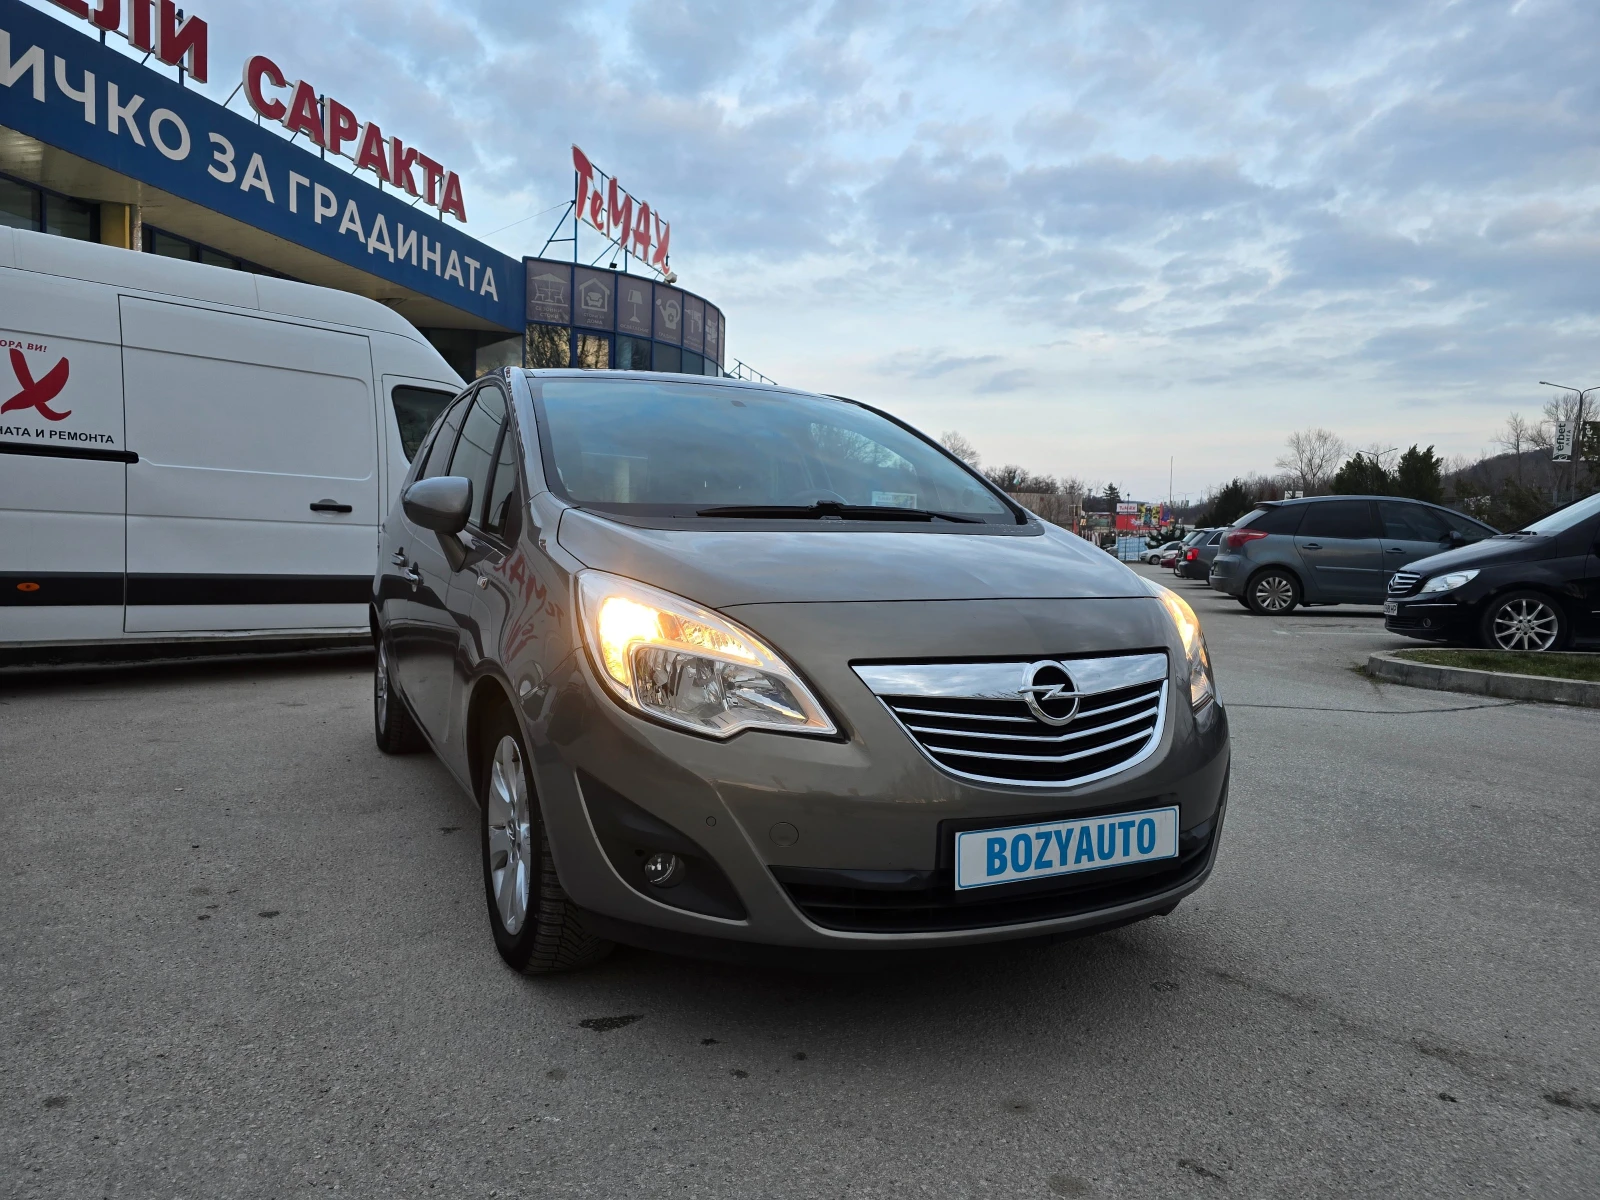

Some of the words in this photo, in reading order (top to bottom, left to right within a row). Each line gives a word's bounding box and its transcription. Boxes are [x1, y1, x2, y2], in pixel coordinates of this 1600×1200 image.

[242, 55, 467, 223] САРАКТА
[0, 29, 191, 161] ИЧКО
[207, 132, 275, 203] ЗА
[289, 170, 499, 302] ГРАДИНАТА
[27, 342, 47, 353] ВИ!
[35, 428, 45, 438] И
[49, 430, 115, 444] РЕМОНТА
[1556, 423, 1566, 451] efbet
[986, 818, 1156, 877] BOZYAUTO
